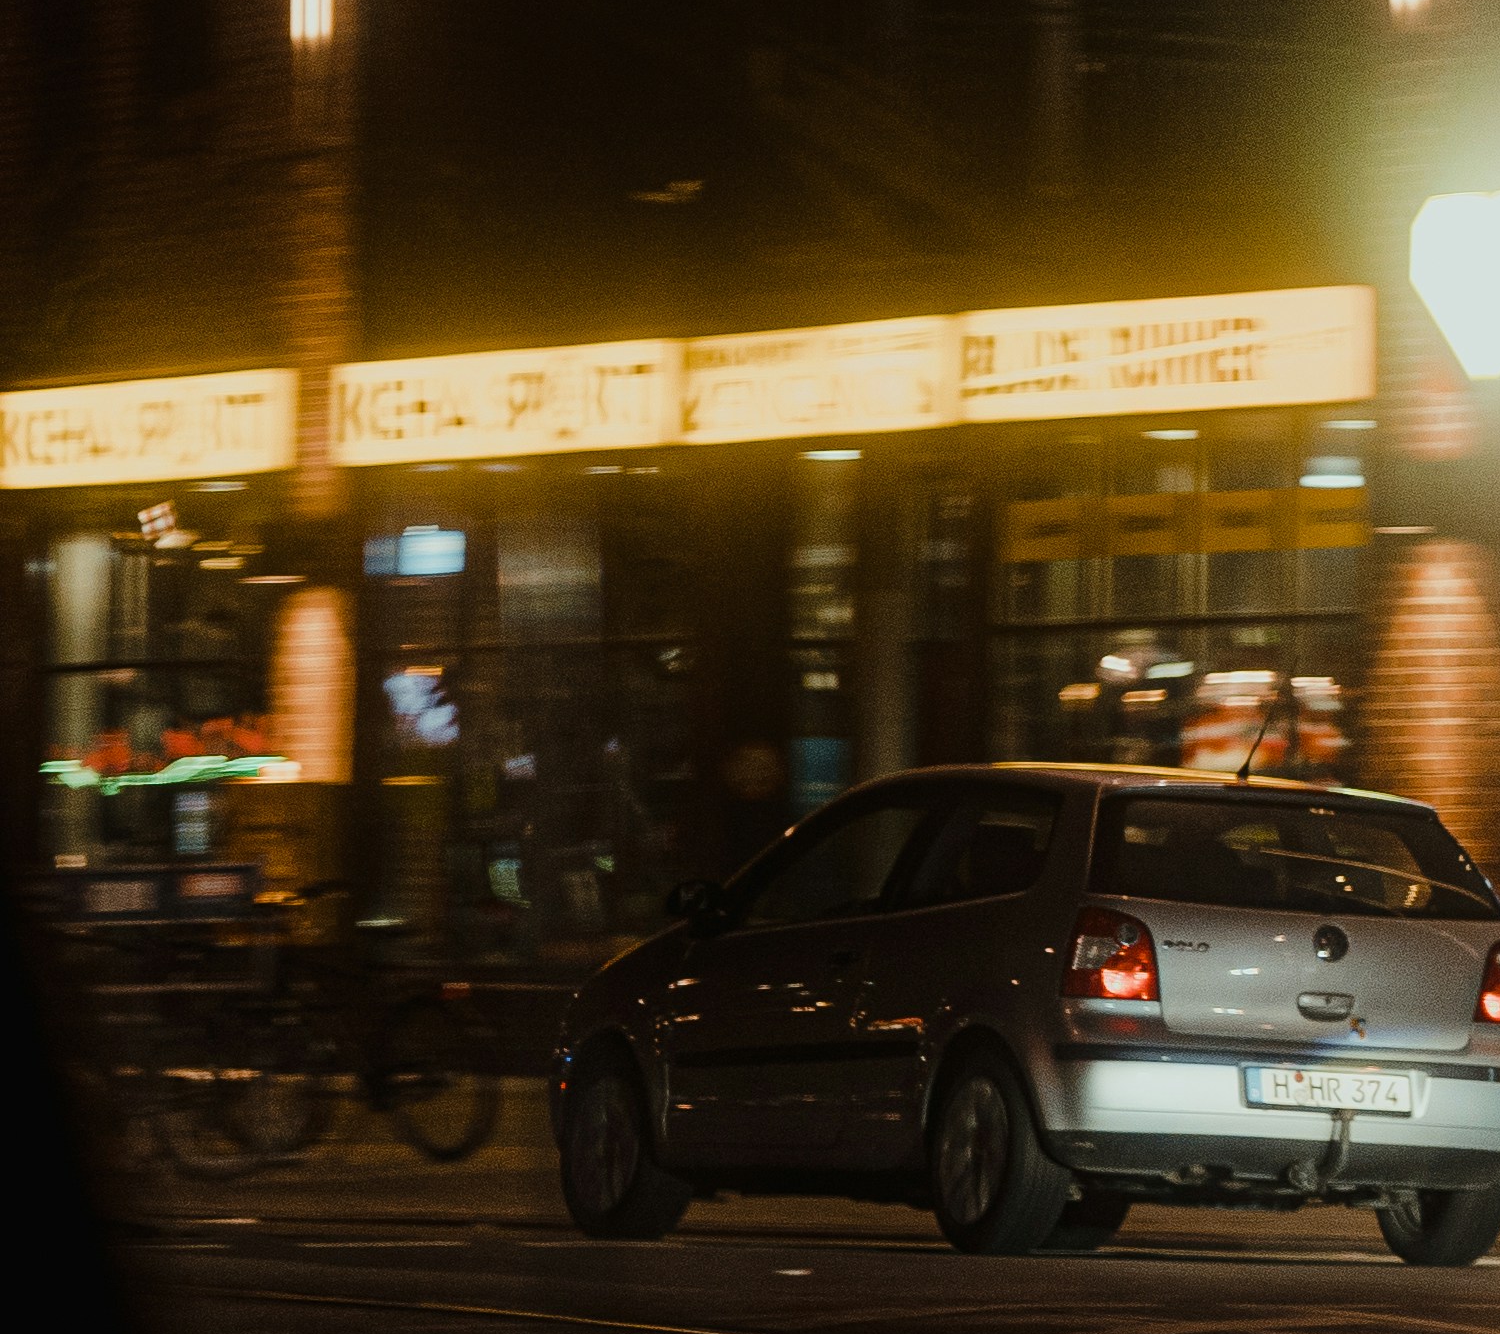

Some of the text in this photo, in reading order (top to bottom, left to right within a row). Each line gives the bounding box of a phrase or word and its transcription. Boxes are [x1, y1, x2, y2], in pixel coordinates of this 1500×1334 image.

[1273, 1074, 1398, 1107] H HR 374
